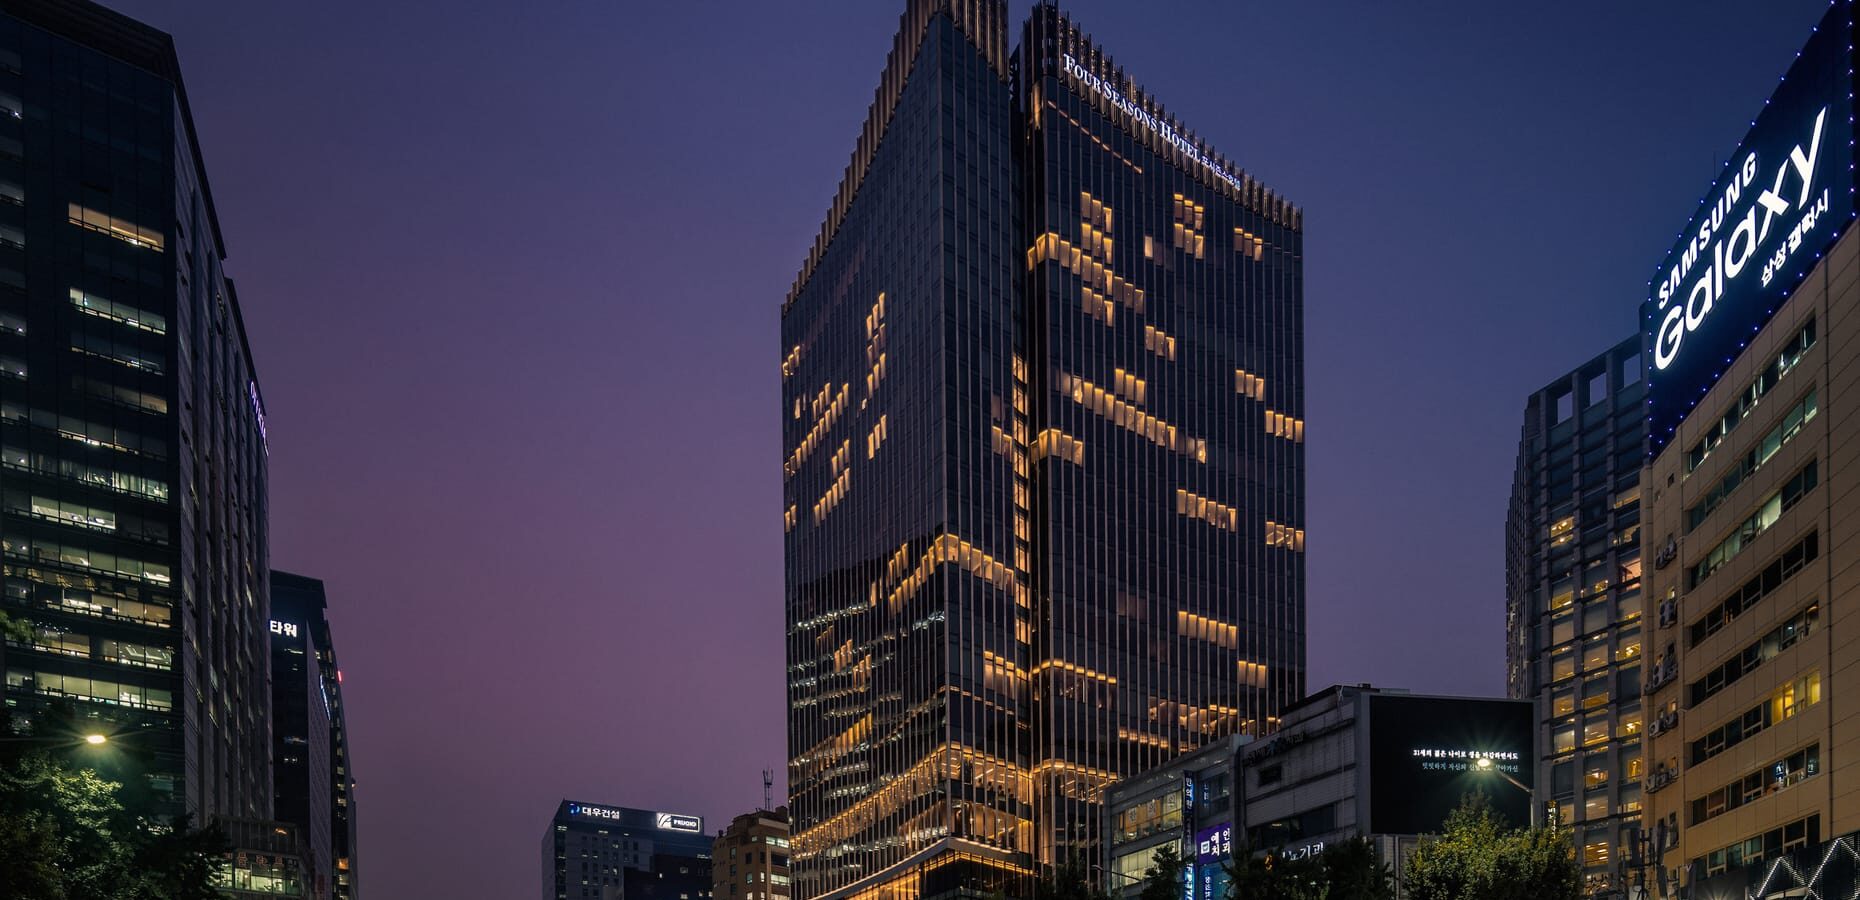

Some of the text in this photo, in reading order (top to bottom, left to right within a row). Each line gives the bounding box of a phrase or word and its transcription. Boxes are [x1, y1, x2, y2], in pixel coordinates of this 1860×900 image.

[1063, 53, 1201, 163] FOUR SEASONS HOTEL
[1654, 106, 1827, 371] Galaxy
[1658, 151, 1758, 310] SAMSUNG
[1761, 241, 1787, 288] 삼성
[269, 619, 297, 638] 타워
[581, 806, 620, 820] 대우건설
